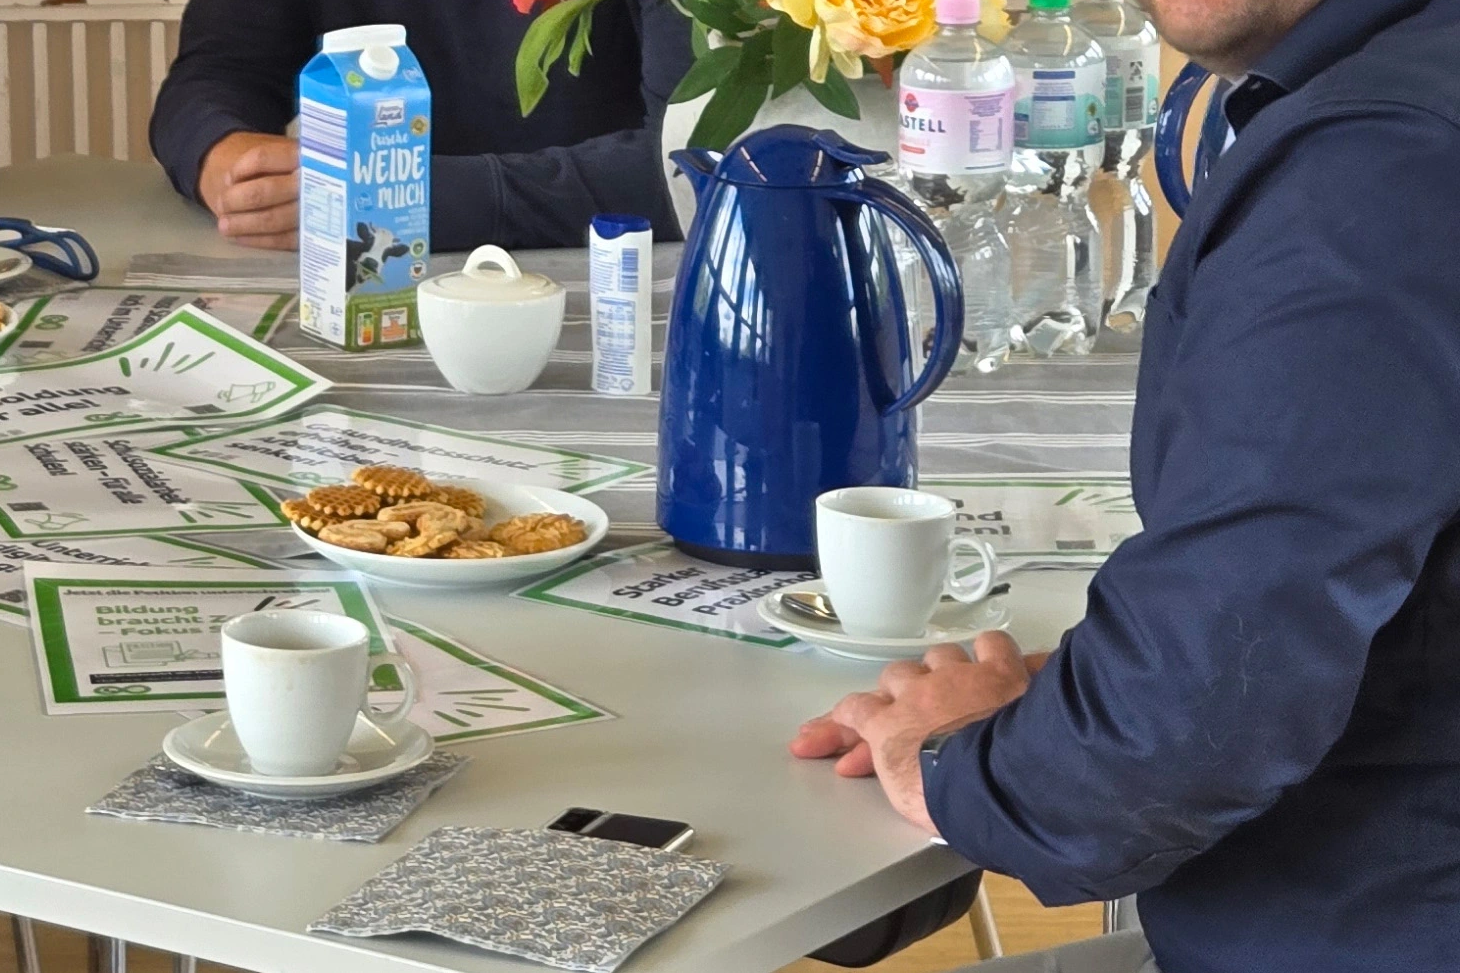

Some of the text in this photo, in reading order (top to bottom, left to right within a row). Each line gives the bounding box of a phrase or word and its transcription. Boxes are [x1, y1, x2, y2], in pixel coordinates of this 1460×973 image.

[353, 145, 426, 185] WEIDE
[612, 566, 708, 599] Starker
[651, 568, 773, 607] Berufssta
[692, 572, 819, 616] Praxisscho
[95, 605, 199, 615] Bildung
[97, 614, 202, 626] braucht
[120, 626, 196, 636] Fokus
